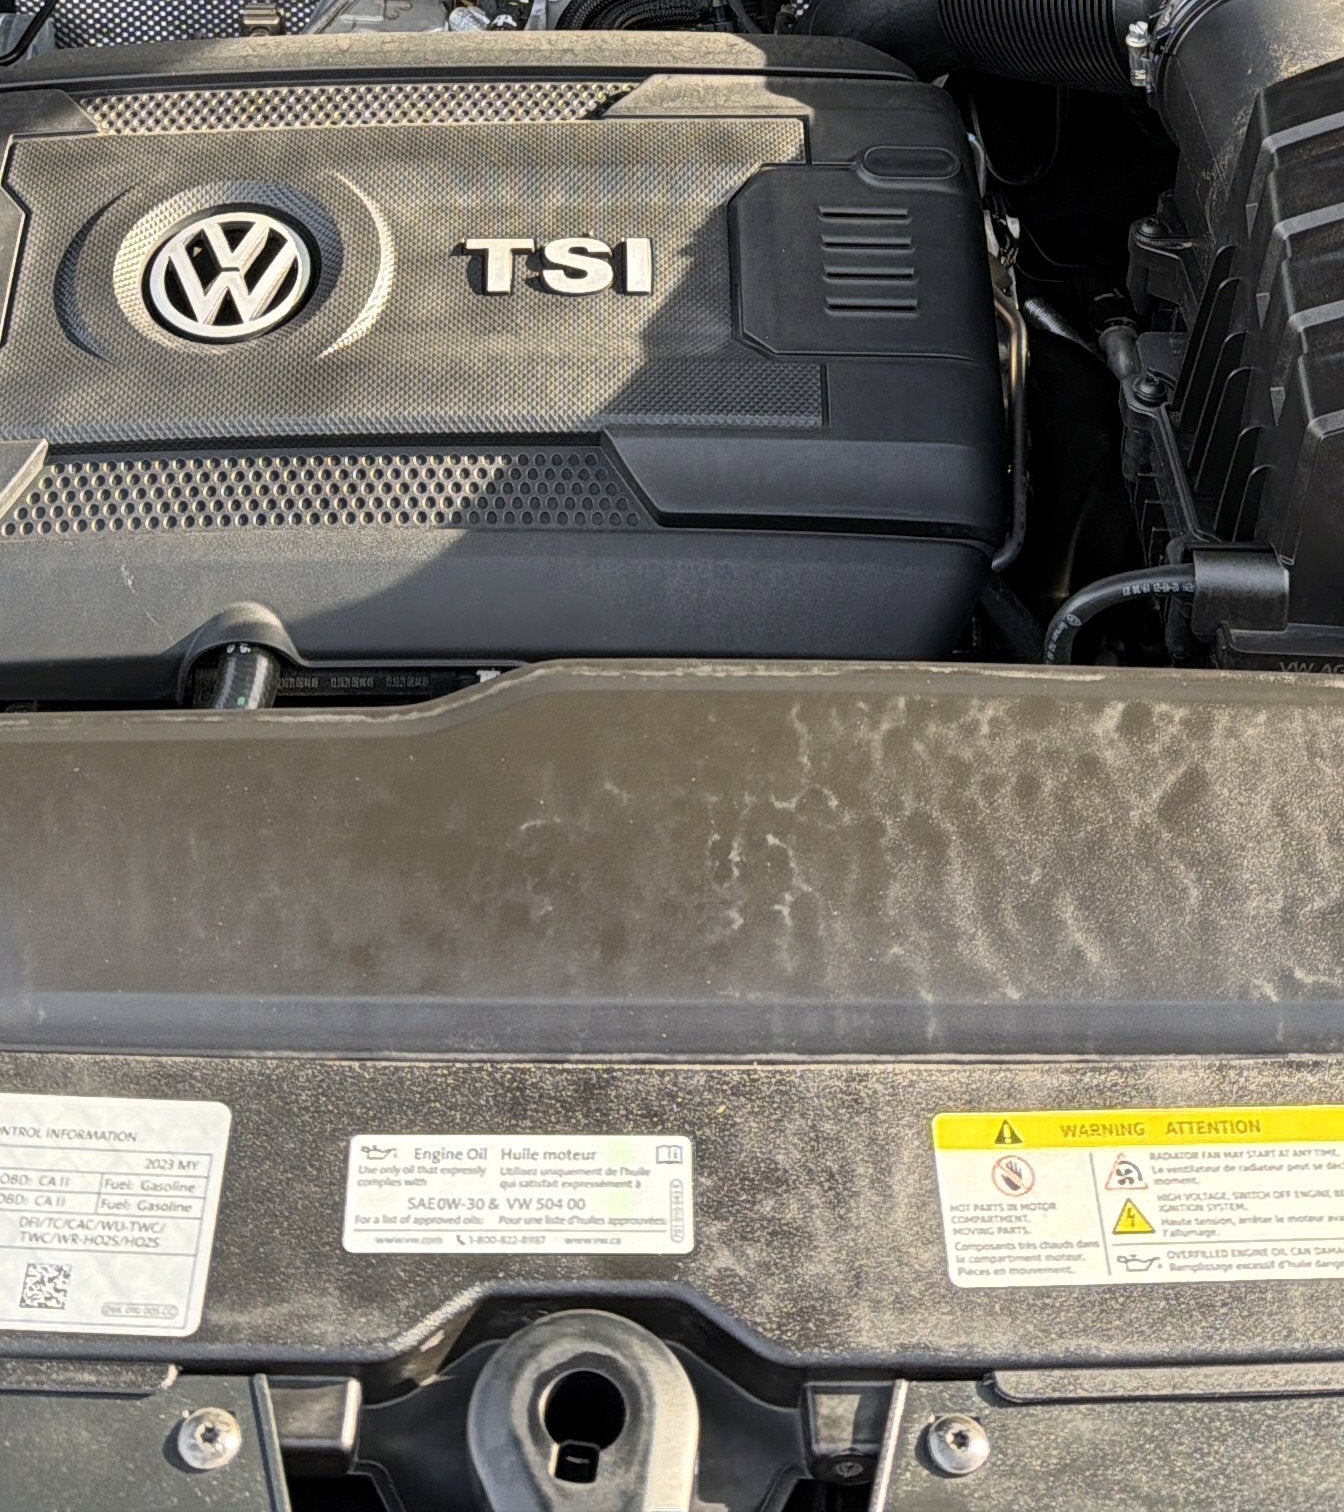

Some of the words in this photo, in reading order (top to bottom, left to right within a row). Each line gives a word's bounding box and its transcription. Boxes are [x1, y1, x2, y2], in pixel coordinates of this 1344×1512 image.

[465, 237, 653, 295] TSI
[46, 1128, 137, 1142] INFORMATION
[1060, 1122, 1146, 1138] WARNING
[1166, 1119, 1262, 1135] ATTENTION
[414, 1148, 463, 1162] Engine
[467, 1148, 487, 1160] Oil
[501, 1148, 539, 1160] Huile
[543, 1149, 597, 1161] moteur
[145, 1158, 174, 1170] 2023
[176, 1159, 200, 1171] MY
[39, 1175, 57, 1188] CA
[141, 1180, 196, 1193] Gasoline
[34, 1195, 56, 1207] CA
[137, 1200, 192, 1213] Gasoline
[507, 1198, 532, 1210] VW
[536, 1198, 563, 1210] 504
[567, 1198, 586, 1210] 00
